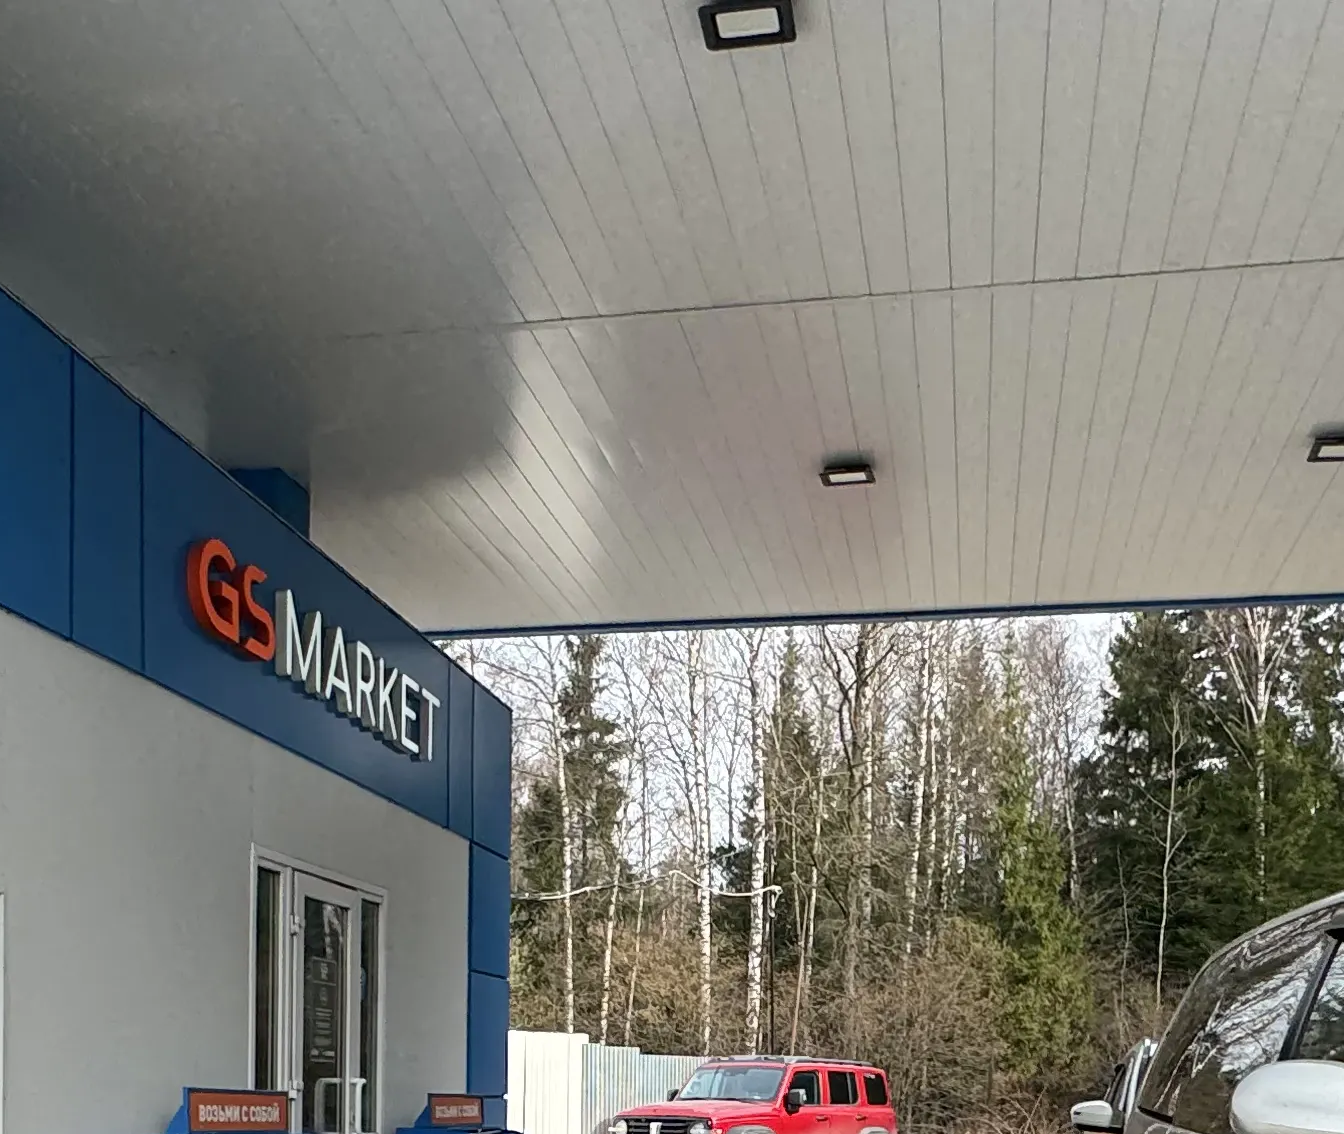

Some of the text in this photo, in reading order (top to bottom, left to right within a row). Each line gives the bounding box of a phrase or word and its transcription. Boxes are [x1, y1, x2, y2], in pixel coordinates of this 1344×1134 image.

[186, 538, 441, 762] GS MARKET
[198, 1102, 281, 1122] ВОЗЬМИ С СОБОЙ
